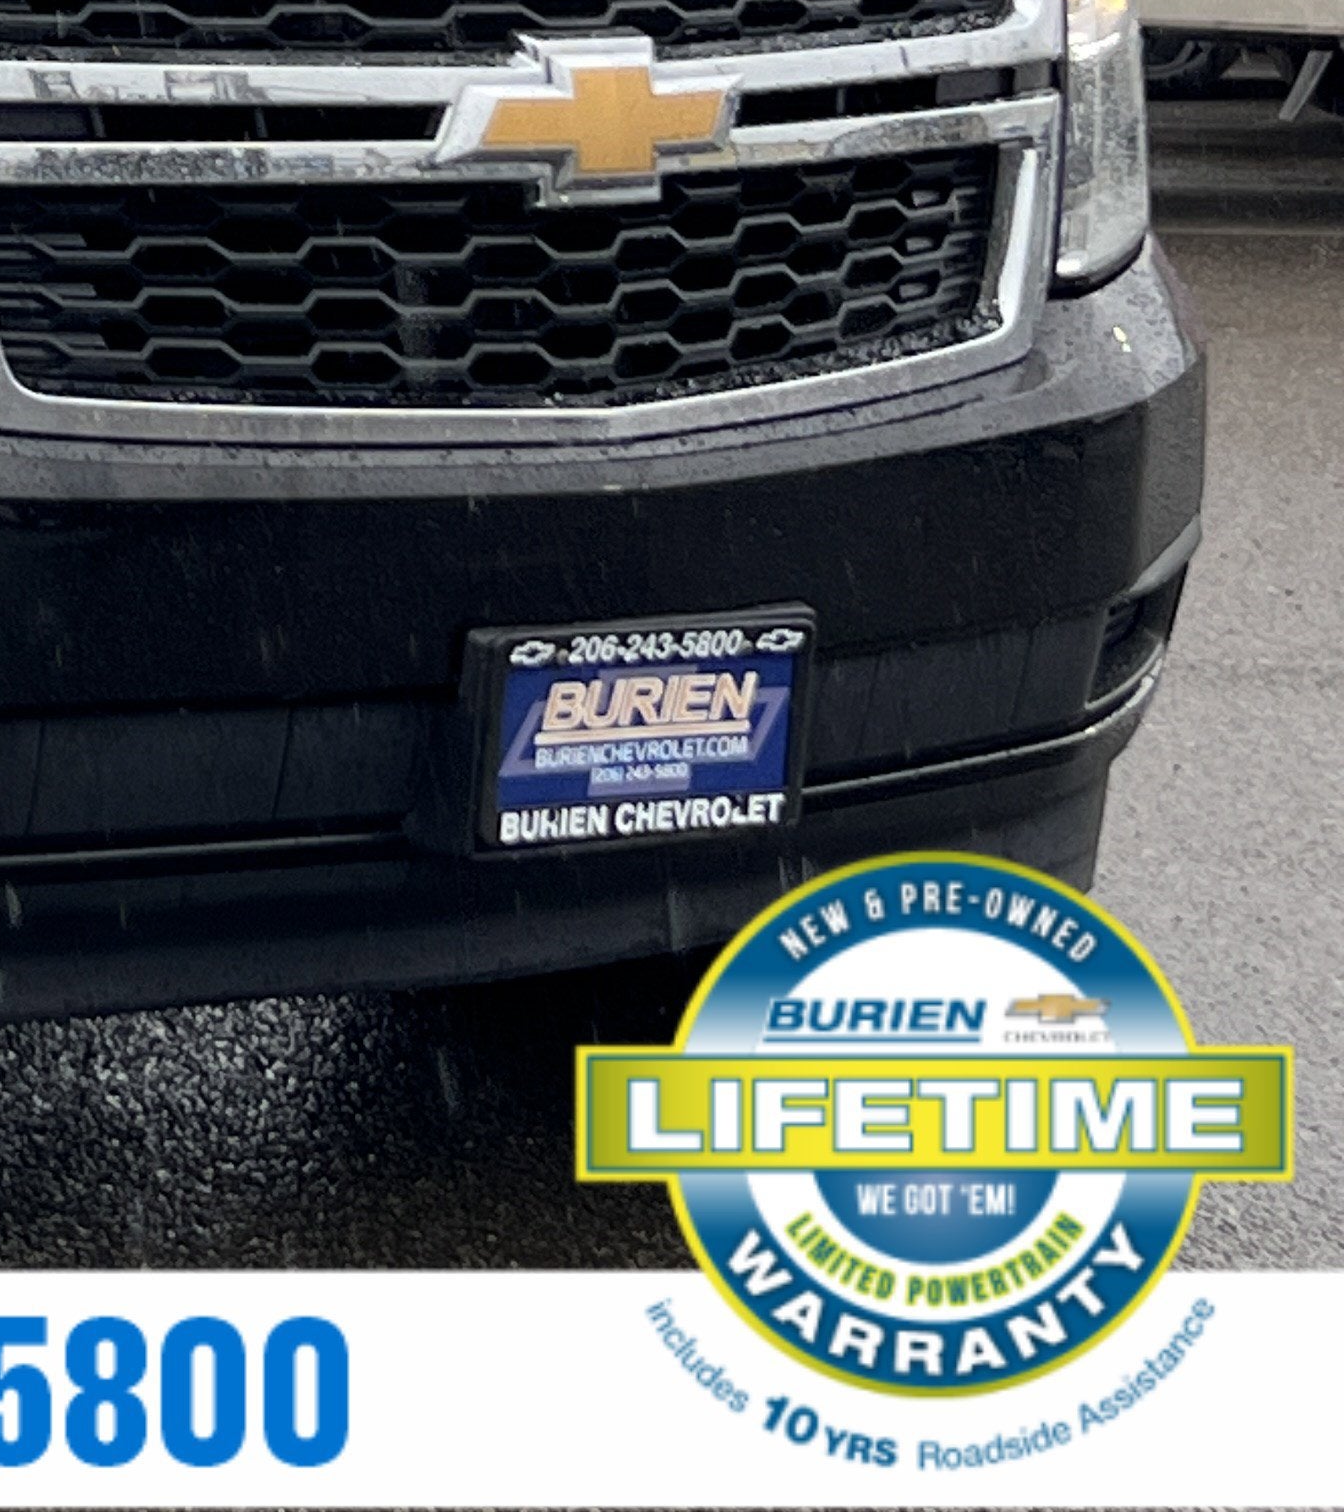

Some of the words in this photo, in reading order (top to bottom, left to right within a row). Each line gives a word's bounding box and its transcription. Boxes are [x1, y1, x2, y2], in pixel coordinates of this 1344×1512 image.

[567, 629, 744, 664] 206-243-5800
[543, 671, 758, 728] BURIEN
[534, 735, 750, 769] BURIENCHEVROLET.COM
